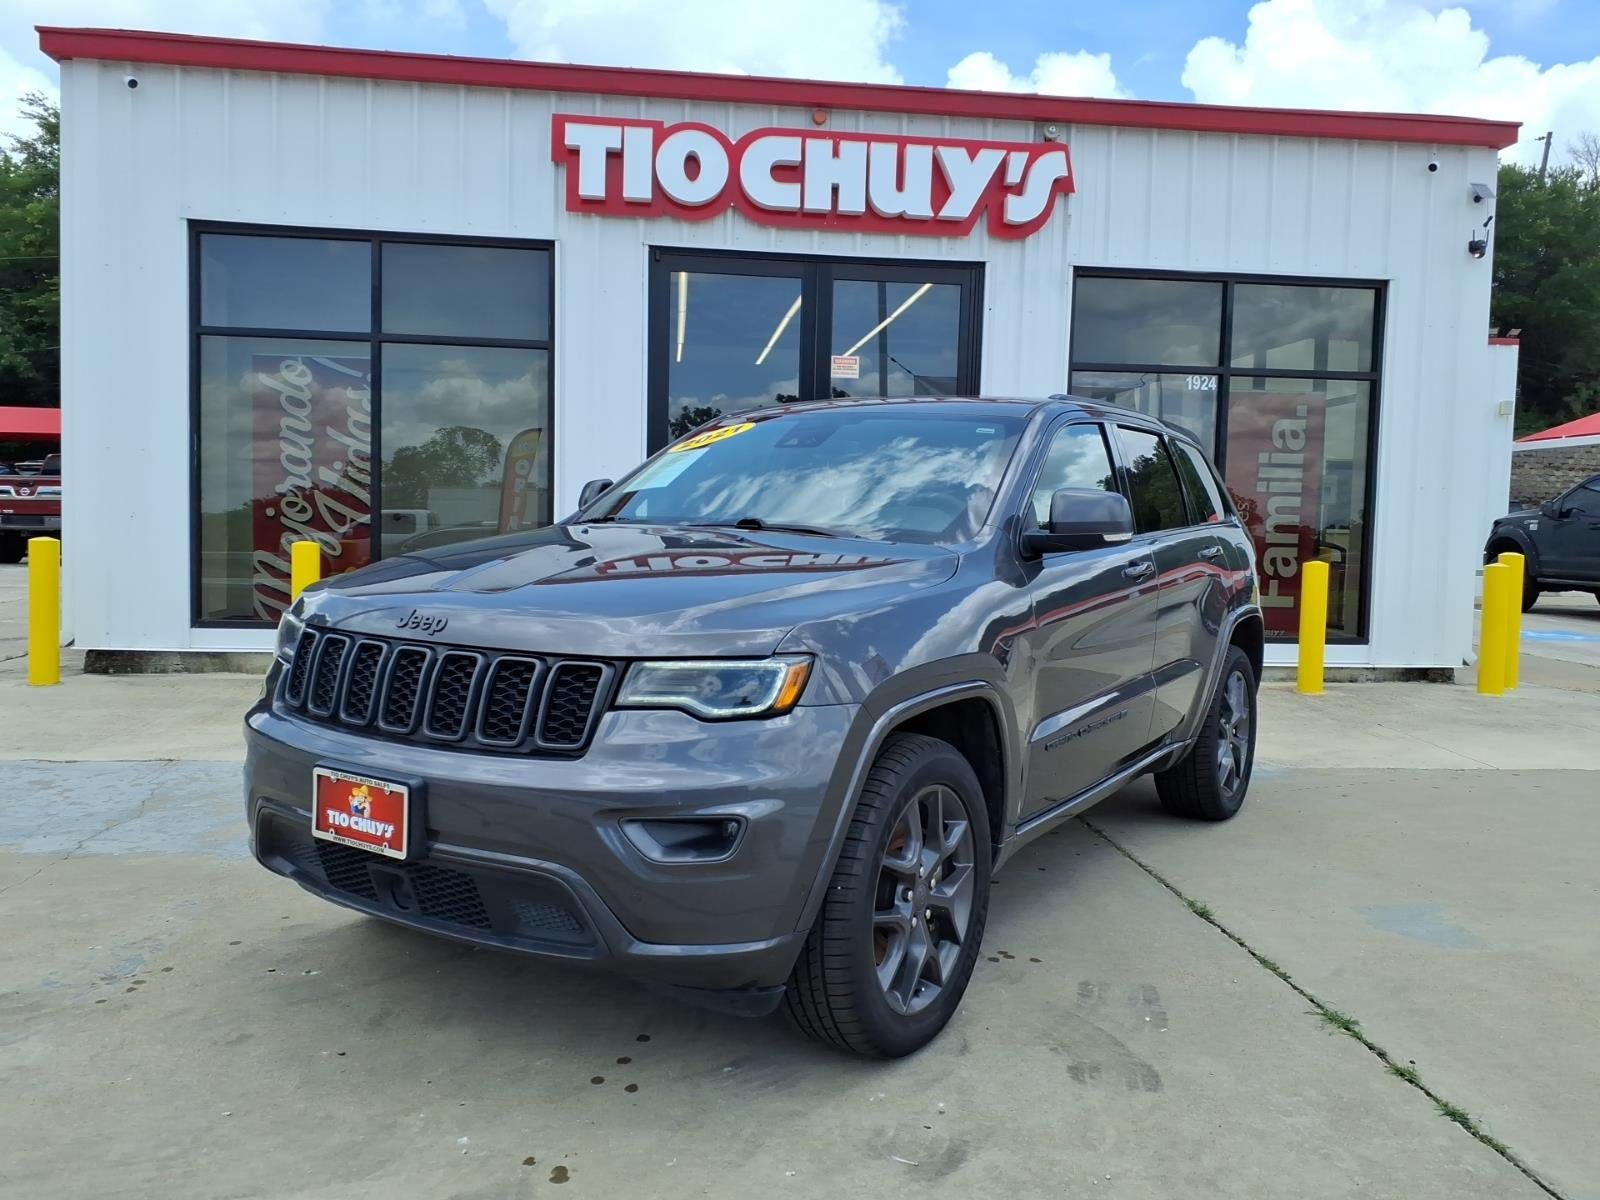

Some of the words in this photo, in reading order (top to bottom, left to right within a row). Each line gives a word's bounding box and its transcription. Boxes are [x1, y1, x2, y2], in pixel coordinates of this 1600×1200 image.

[564, 122, 729, 207] TIO
[1185, 375, 1217, 391] 1924
[396, 609, 449, 636] Jeep
[327, 809, 350, 827] TIO
